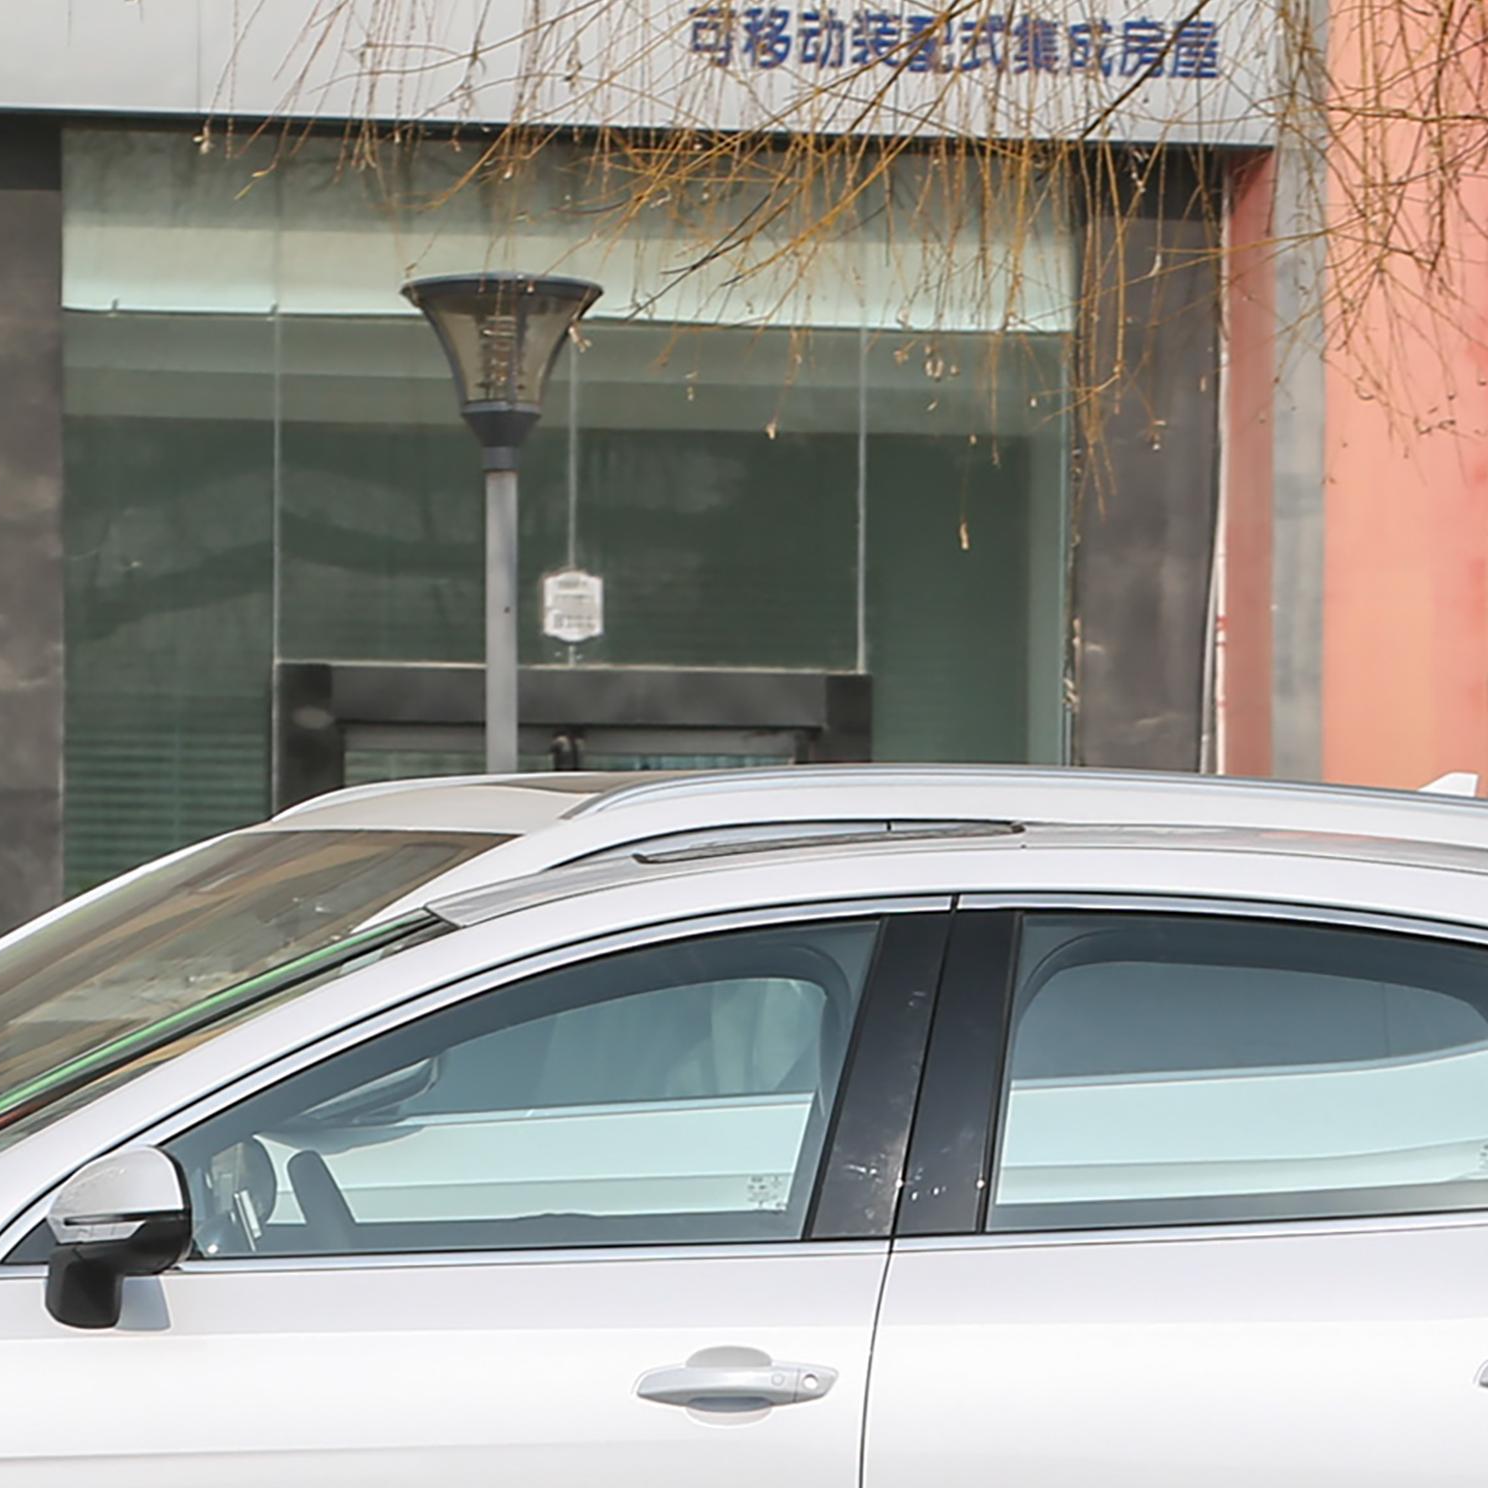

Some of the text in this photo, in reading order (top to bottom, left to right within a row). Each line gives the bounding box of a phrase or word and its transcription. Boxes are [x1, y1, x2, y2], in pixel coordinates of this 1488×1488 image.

[689, 8, 1219, 79] 可移动装配式集成房屋
